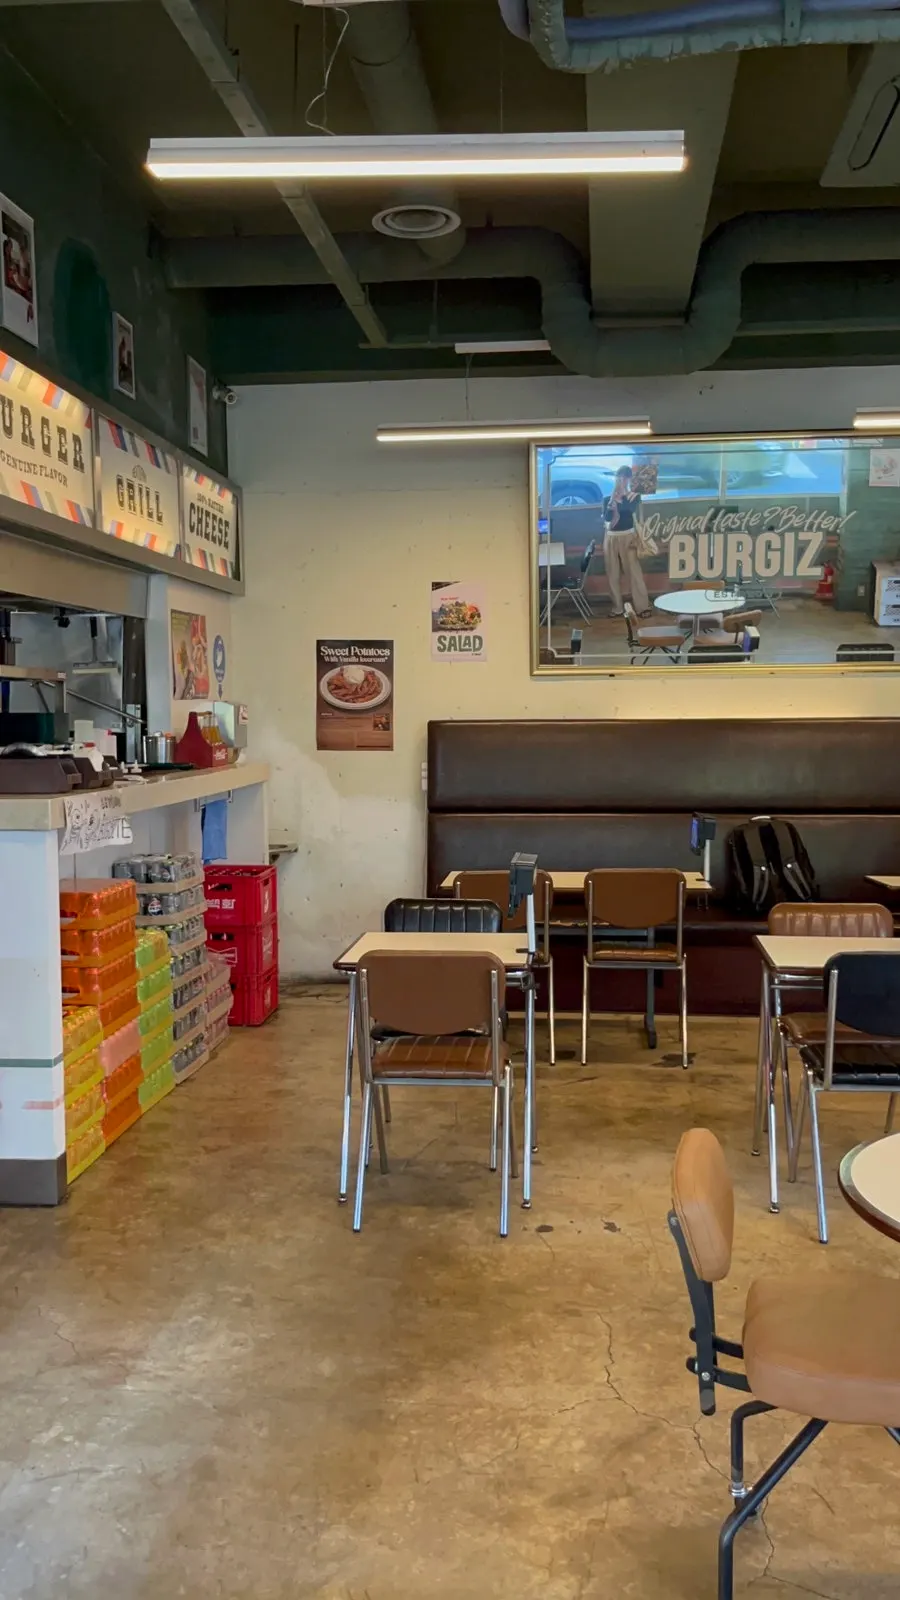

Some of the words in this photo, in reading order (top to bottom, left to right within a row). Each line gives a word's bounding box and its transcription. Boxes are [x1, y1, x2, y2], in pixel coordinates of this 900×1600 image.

[39, 465, 68, 488] FLAVOR
[116, 474, 163, 526] GRILL
[189, 502, 230, 550] CHEESE
[643, 506, 715, 543] Original
[775, 506, 857, 533] Better!
[668, 531, 825, 580] BURGIZ
[320, 645, 349, 656] Sweet
[350, 645, 391, 656] Potatoes
